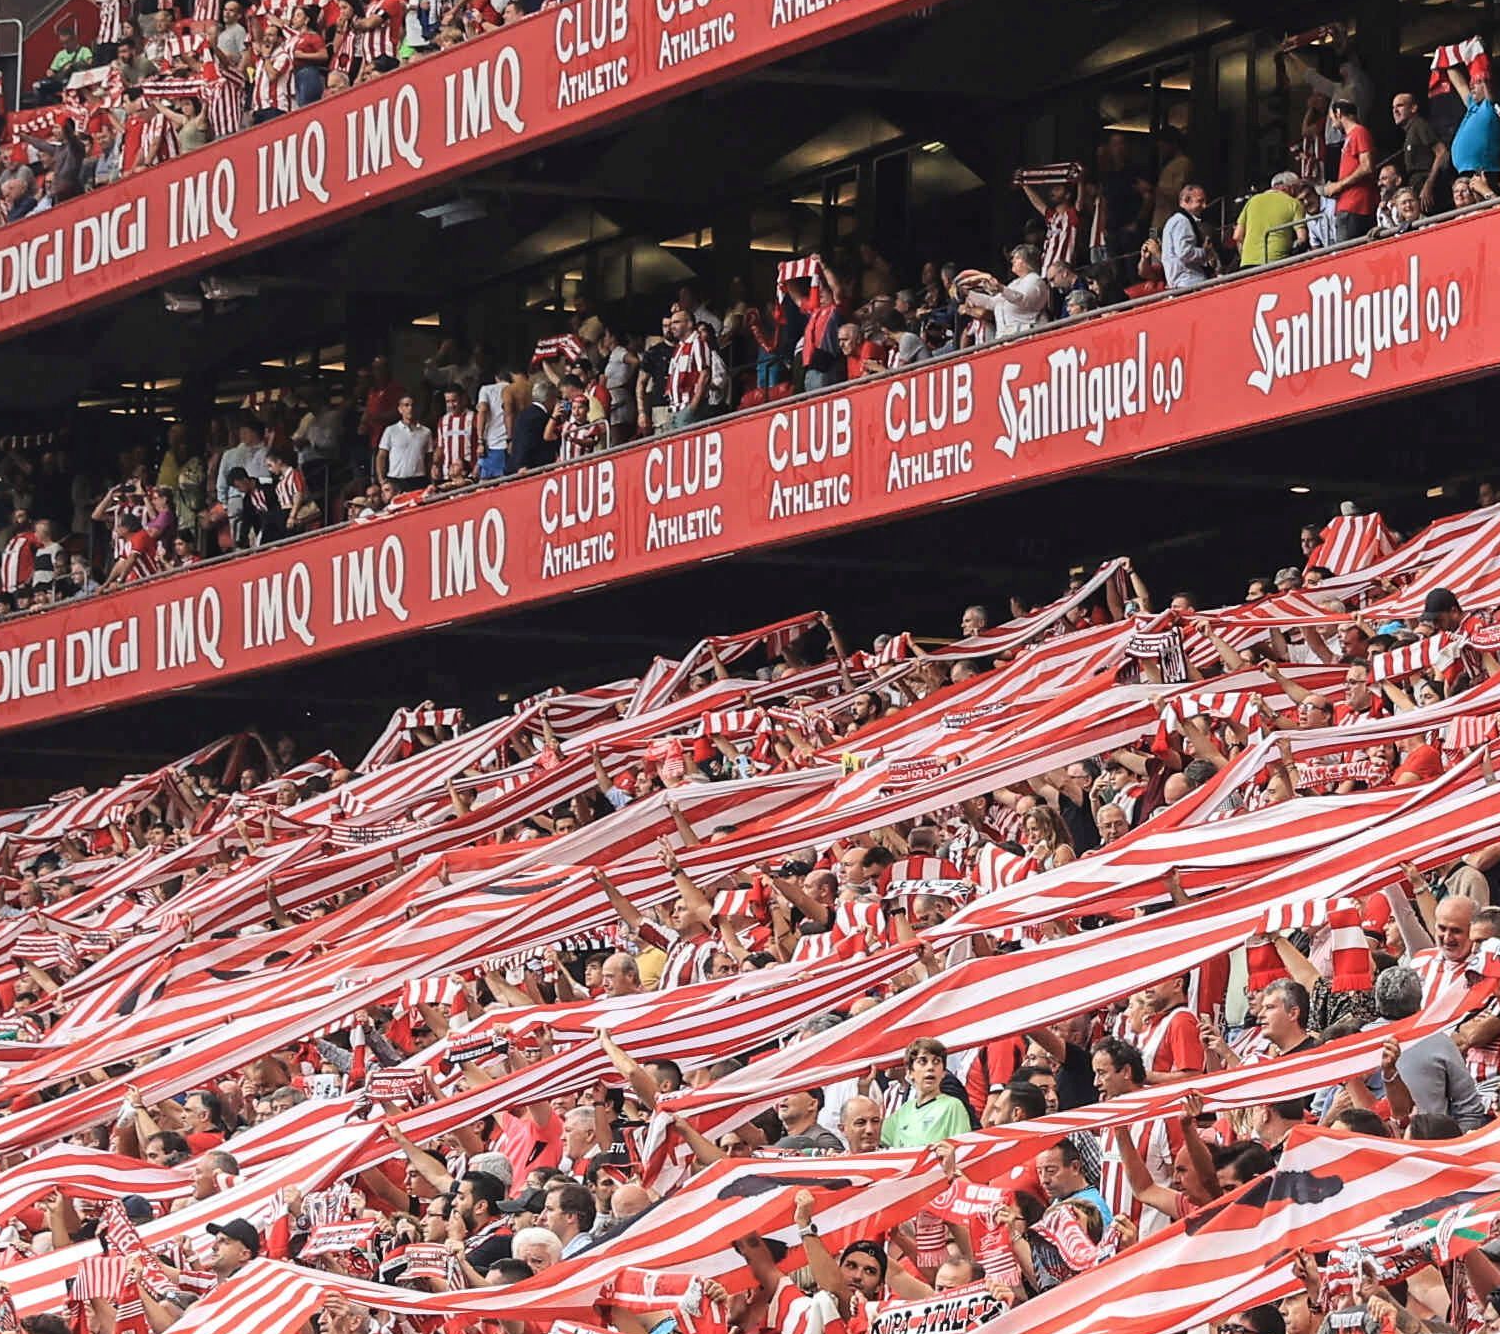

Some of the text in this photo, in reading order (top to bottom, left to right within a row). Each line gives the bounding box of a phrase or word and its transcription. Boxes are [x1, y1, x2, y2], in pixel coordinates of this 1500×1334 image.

[659, 11, 736, 69] ATHLETIC
[445, 46, 525, 146] IMQ
[557, 56, 628, 109] ATHLETIC
[258, 120, 330, 214] IMQ
[346, 83, 423, 181] IMQ
[73, 197, 146, 275] DIGI
[169, 158, 238, 248] IMQ
[767, 397, 852, 472] CLUB
[884, 362, 973, 443] CLUB
[540, 460, 615, 535] CLUB
[645, 431, 724, 506] CLUB
[769, 473, 851, 520] ATHLETIC
[886, 440, 972, 494] ATHLETIC
[430, 507, 509, 600] IMQ
[541, 531, 614, 581] ATHLETIC
[646, 505, 722, 553] ATHLETIC
[242, 562, 315, 649] IMQ
[332, 534, 409, 625] IMQ
[66, 617, 138, 687] DIGI
[155, 586, 224, 671] IMQ
